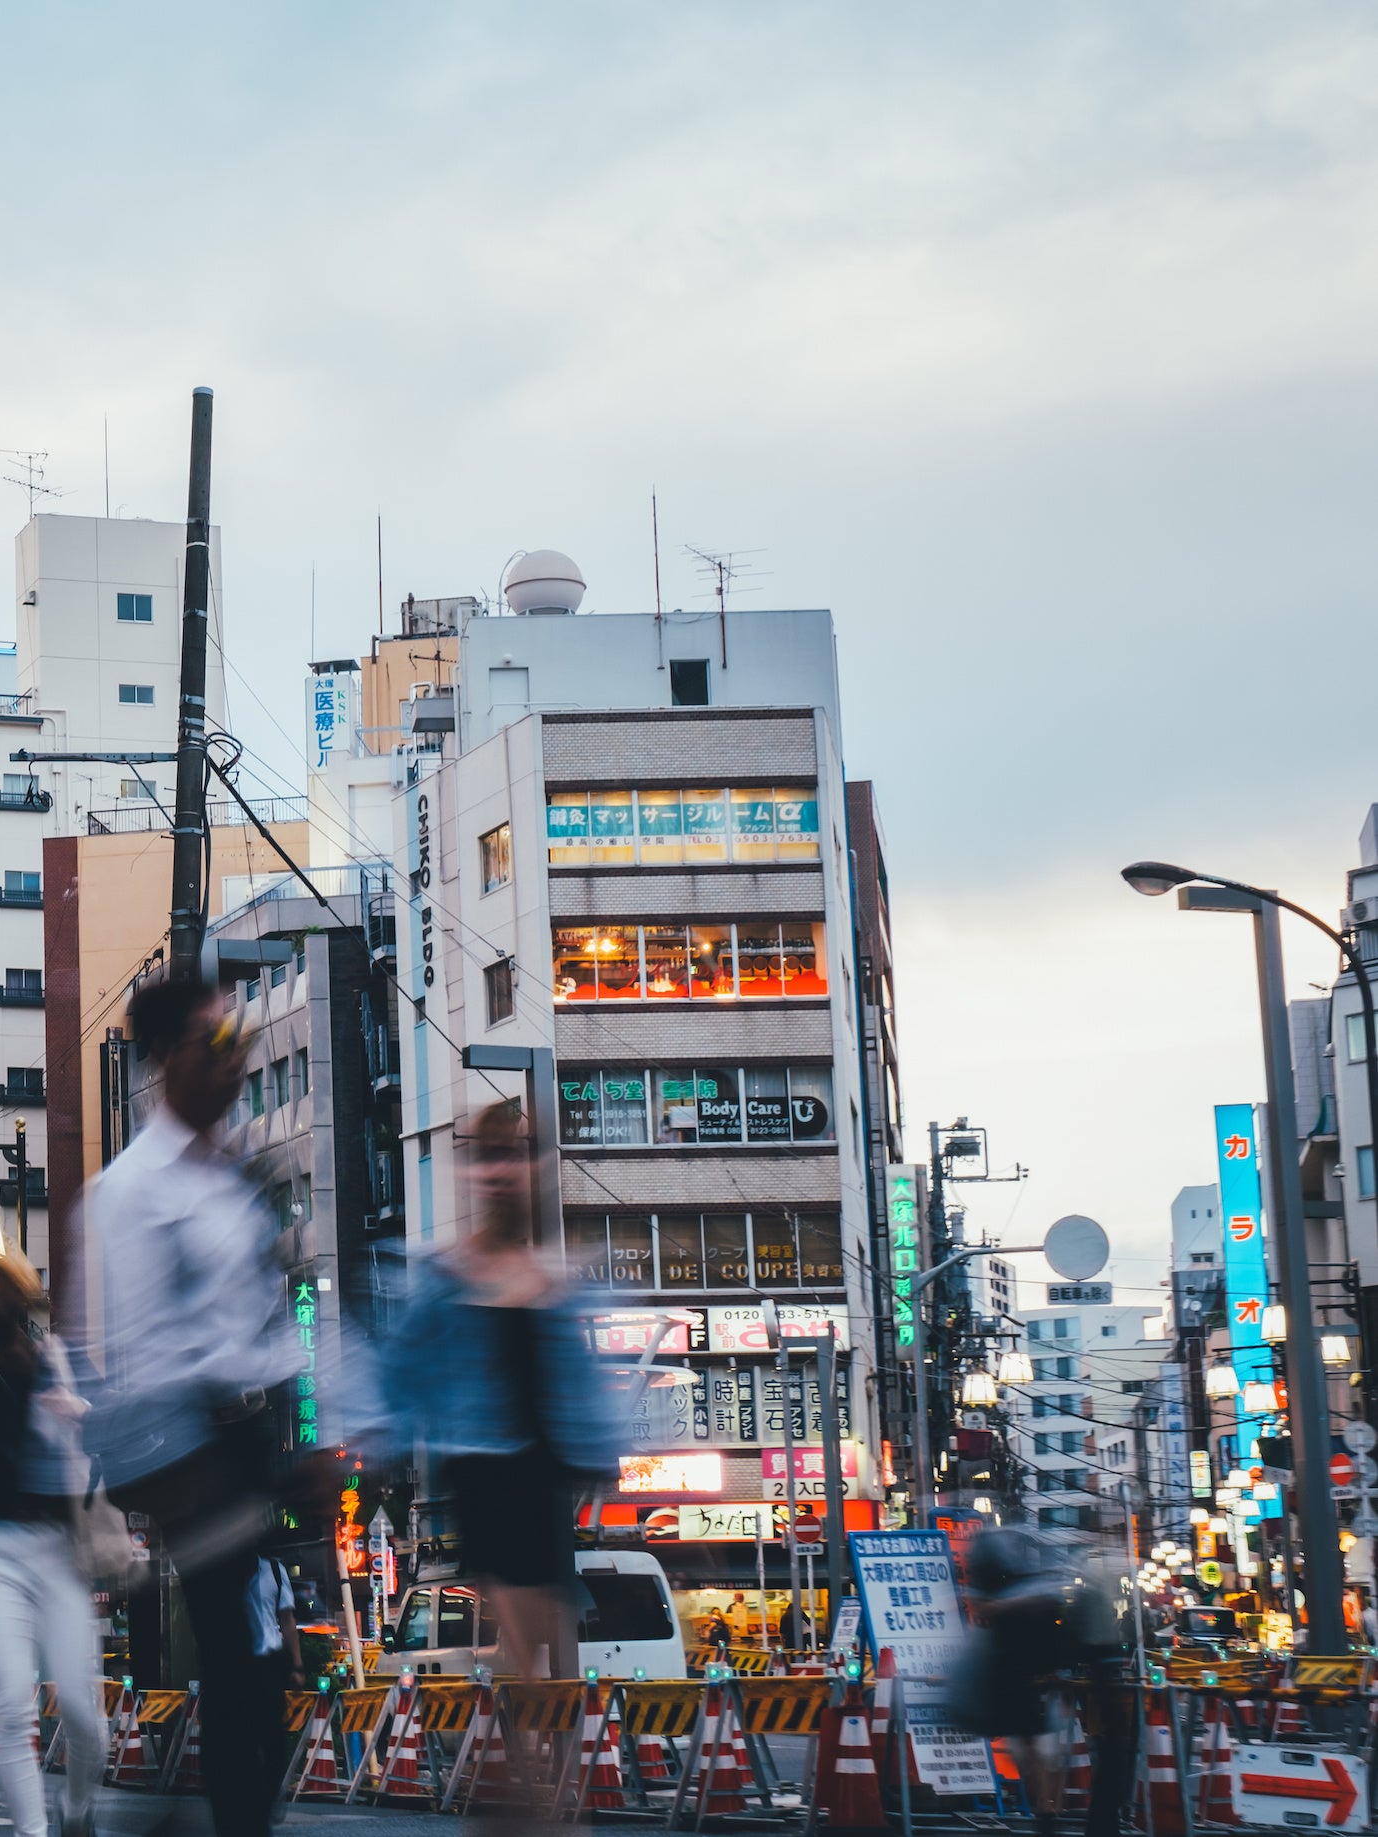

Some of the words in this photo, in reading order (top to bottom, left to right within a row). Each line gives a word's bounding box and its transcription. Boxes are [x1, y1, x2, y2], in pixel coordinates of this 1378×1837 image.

[314, 678, 334, 689] 大塚
[337, 690, 347, 725] KSK
[421, 905, 434, 988] BLDG
[561, 1081, 645, 1101] てんち堂
[570, 1110, 583, 1120] Tel
[701, 1100, 738, 1117] Body
[747, 1100, 781, 1115] Care
[613, 1248, 651, 1260] サロン
[668, 1263, 698, 1281] DE
[721, 1261, 799, 1280] COUPE
[738, 1371, 752, 1401] 国産
[715, 1379, 735, 1432] 時計
[693, 1406, 709, 1438] 小物
[884, 1609, 946, 1631] をしています
